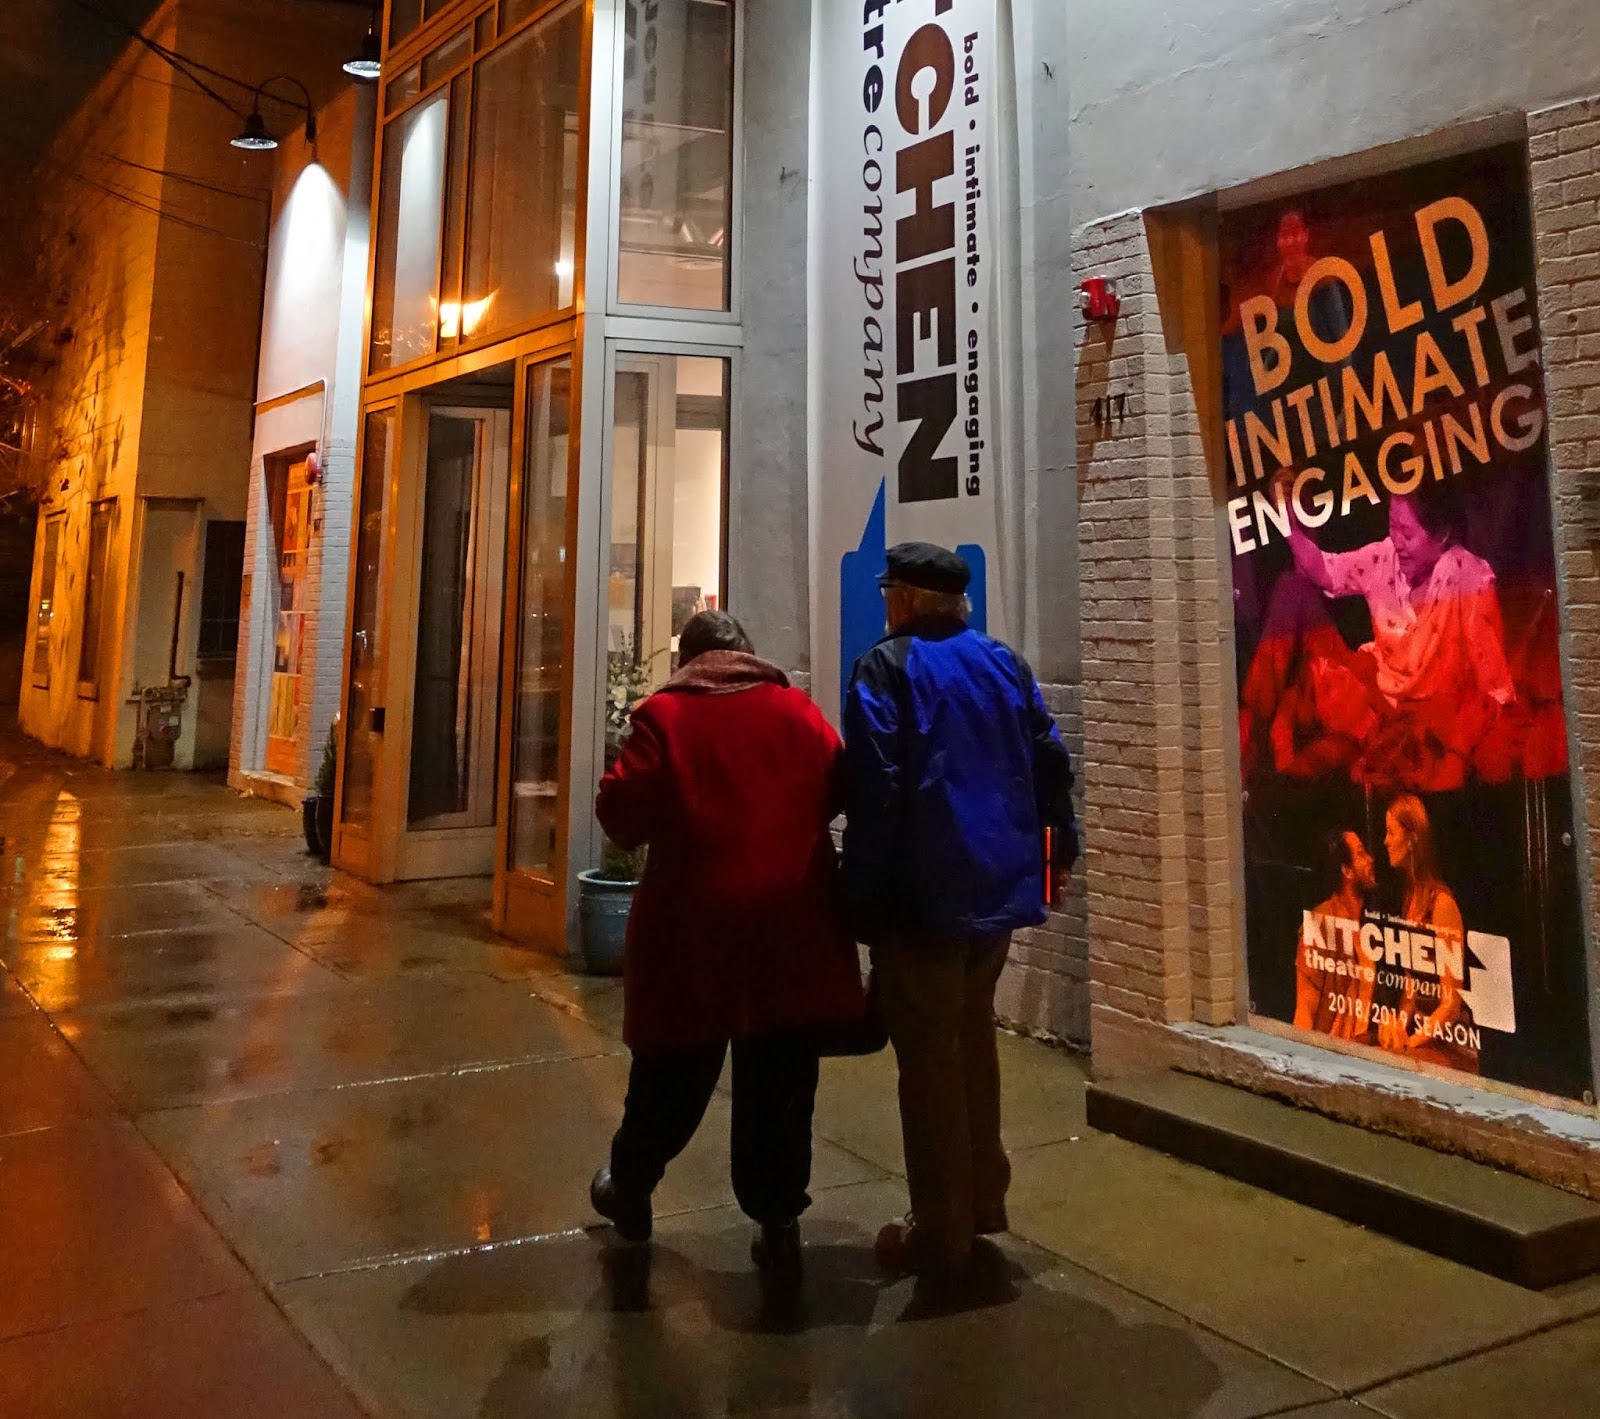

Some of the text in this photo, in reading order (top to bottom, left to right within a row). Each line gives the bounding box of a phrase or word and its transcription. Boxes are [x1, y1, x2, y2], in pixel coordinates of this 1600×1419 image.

[853, 124, 885, 457] company
[895, 0, 959, 504] CHEN
[964, 31, 983, 498] bold intimate engaging
[1239, 196, 1490, 396] BOLD
[1225, 287, 1541, 487] INTIMATE
[1227, 384, 1543, 555] ENGAGING
[1303, 909, 1463, 981] KITCHEN
[1304, 949, 1375, 983] theatre
[1413, 1012, 1482, 1050] SEASON
